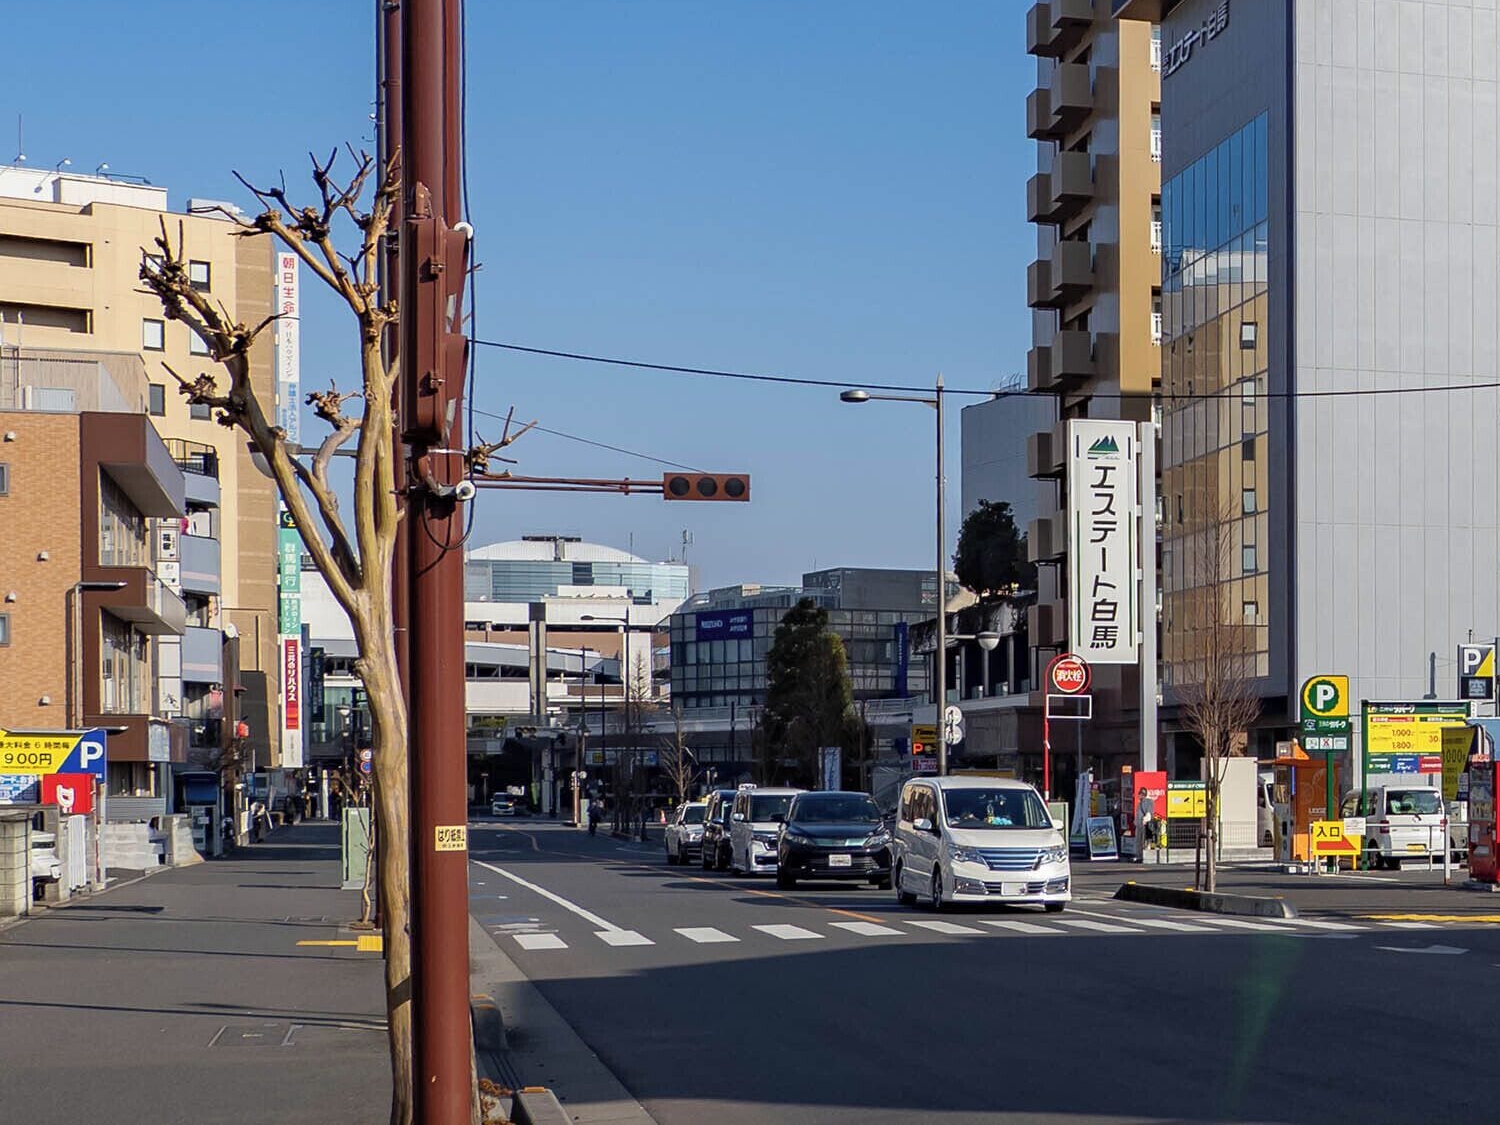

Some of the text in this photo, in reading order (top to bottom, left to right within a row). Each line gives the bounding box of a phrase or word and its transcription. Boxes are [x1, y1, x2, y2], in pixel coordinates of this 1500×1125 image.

[1090, 466, 1119, 649] エステート白馬
[1464, 649, 1481, 673] P
[1316, 684, 1335, 709] P
[80, 741, 104, 769] P
[1316, 827, 1340, 837] 入口
